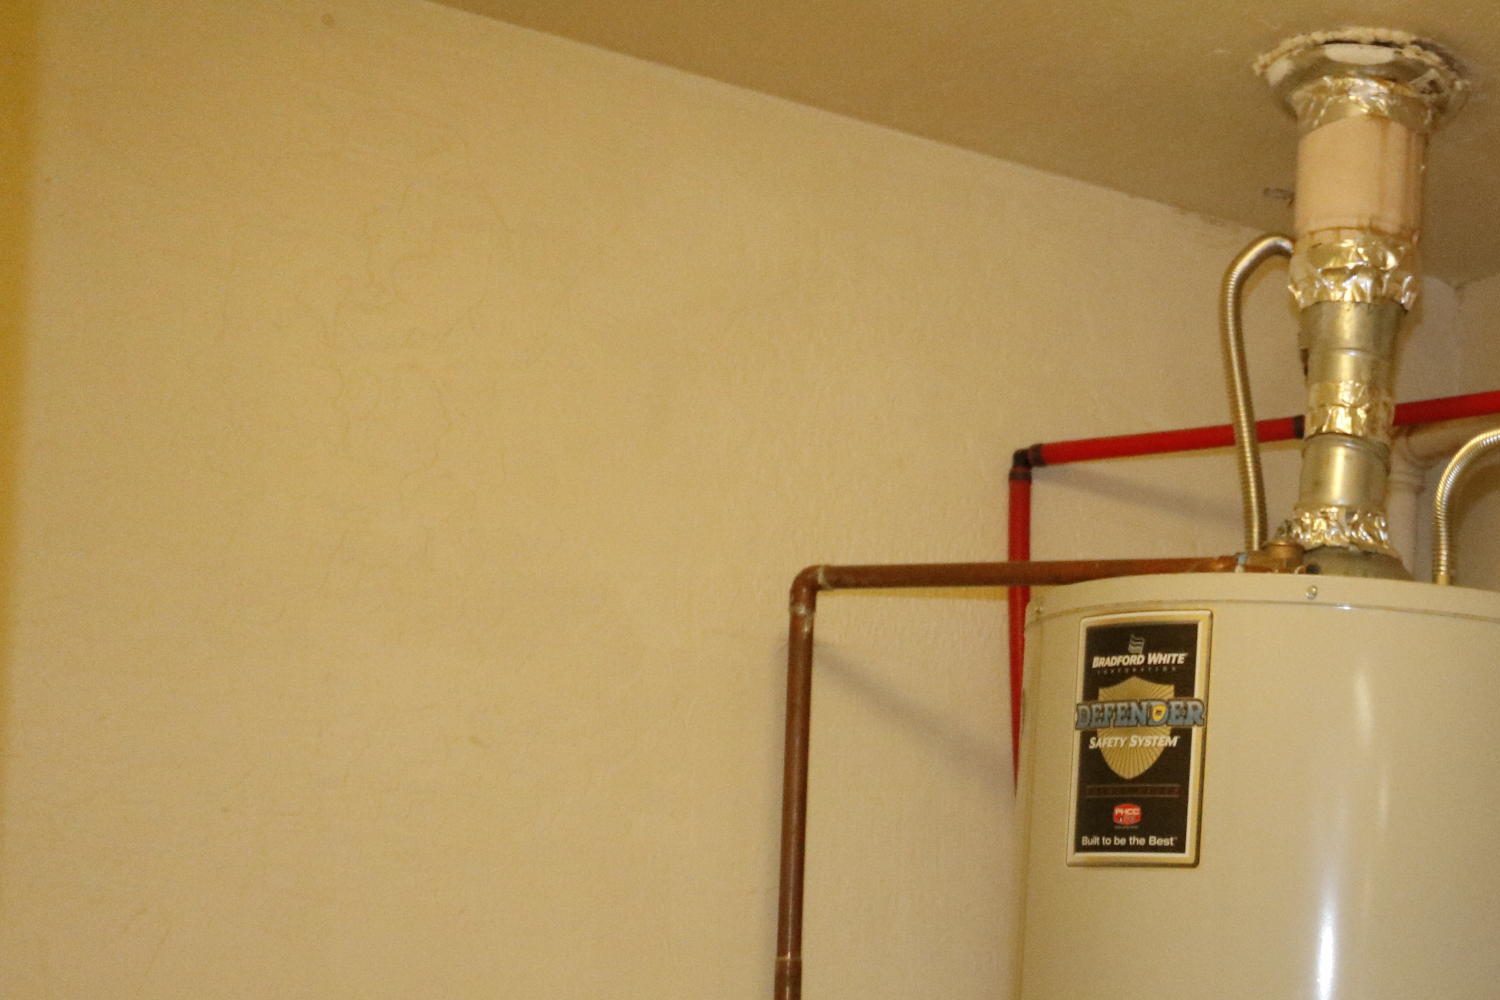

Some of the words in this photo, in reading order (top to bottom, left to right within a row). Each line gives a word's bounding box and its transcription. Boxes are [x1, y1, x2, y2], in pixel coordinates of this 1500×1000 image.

[1091, 654, 1146, 669] BRADFORD
[1147, 652, 1186, 665] WHITE
[1075, 699, 1206, 729] DEFENDER
[1088, 736, 1129, 749] SAFETY
[1129, 735, 1179, 748] SYSTEM
[1081, 836, 1100, 846] Built
[1101, 836, 1112, 846] to
[1113, 835, 1127, 846] be
[1129, 835, 1147, 846] the
[1148, 836, 1174, 846] Best
